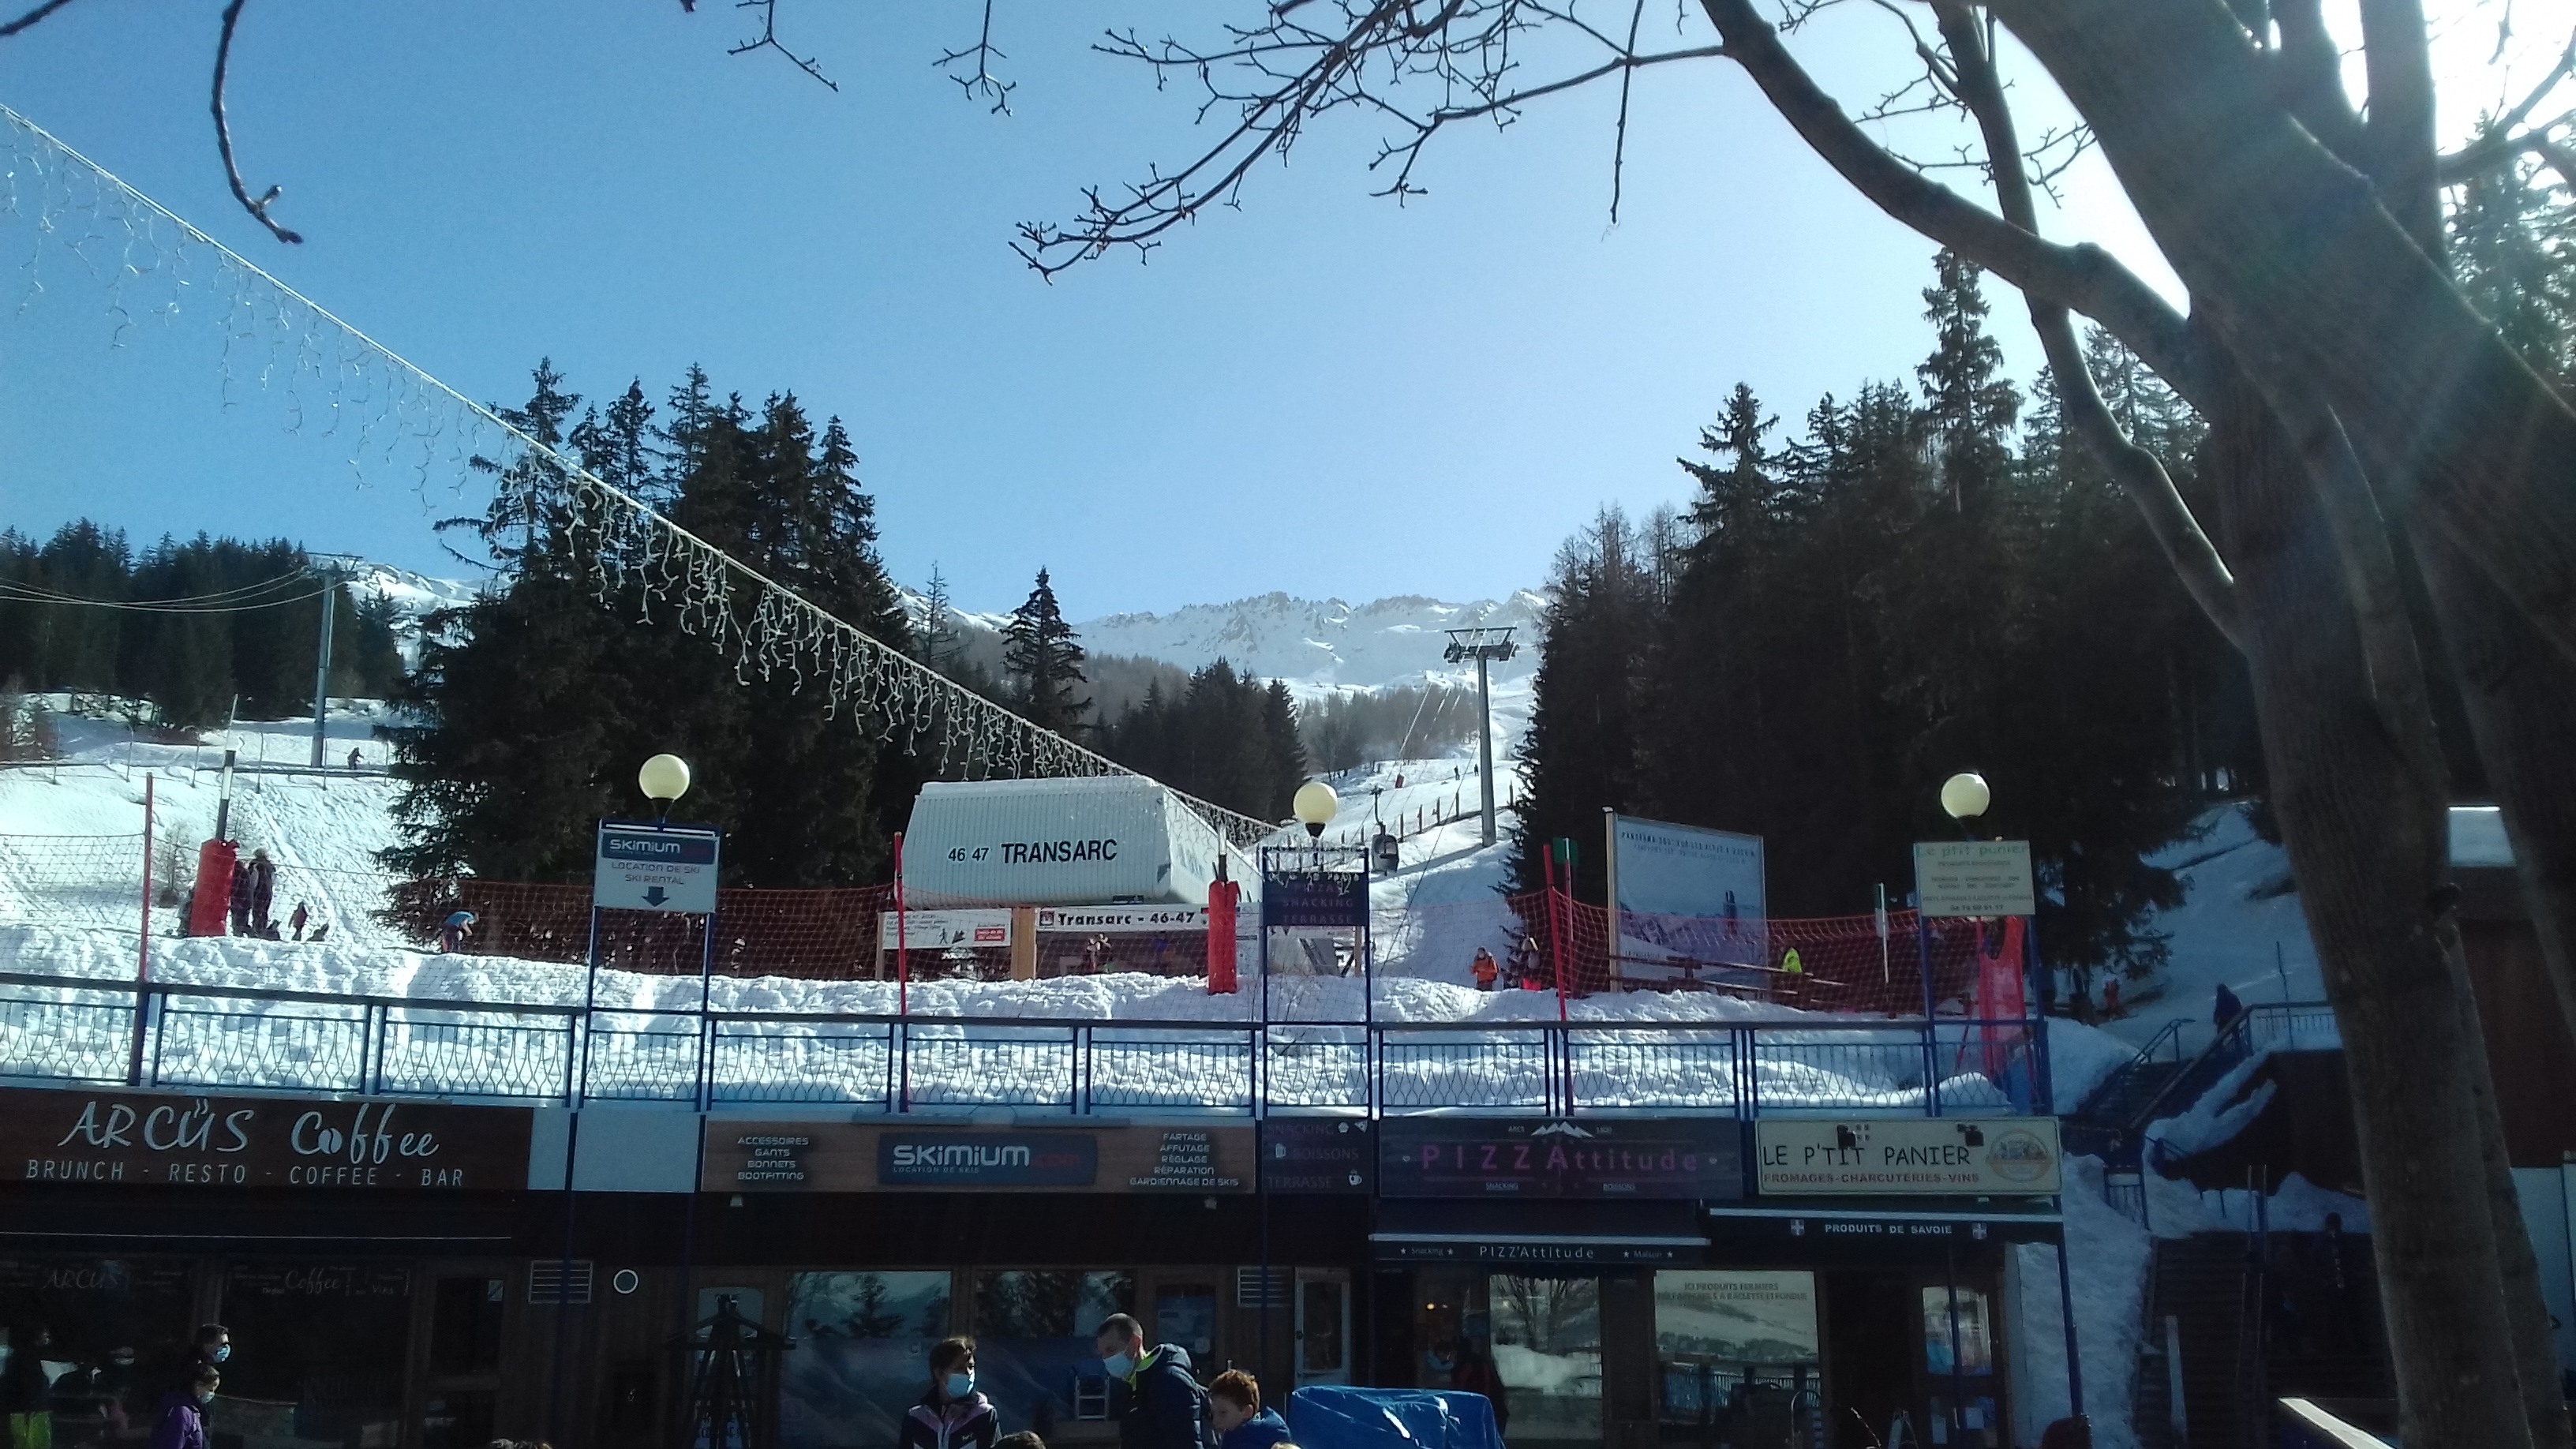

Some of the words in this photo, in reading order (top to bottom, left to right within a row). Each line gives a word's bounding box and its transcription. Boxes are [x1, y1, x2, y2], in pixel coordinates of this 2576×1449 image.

[948, 848, 965, 862] 46
[972, 847, 990, 861] 47
[1001, 838, 1118, 863] TRANSARC
[666, 865, 681, 874] DE
[683, 866, 701, 874] SKI
[624, 874, 642, 882] SKI
[1282, 898, 1354, 908] SNACKING
[1058, 912, 1132, 927] Transarc
[1149, 912, 1196, 924] 46-47
[291, 1103, 440, 1166] Coffee
[1163, 1133, 1208, 1142] FARTAGE
[737, 1136, 810, 1146] ACCESSOIRES
[754, 1148, 791, 1158] GANTS
[1159, 1144, 1211, 1153] AFFUTAGE
[1161, 1154, 1208, 1164] RÉGLAGE
[1763, 1145, 1788, 1166] LE
[1804, 1144, 1866, 1166] P'TIT
[1884, 1144, 1971, 1166] PANIER
[747, 1160, 796, 1169] BONNETS
[26, 1159, 125, 1181] BRUNCH
[169, 1163, 247, 1184] RESTO
[290, 1166, 377, 1186] COFFEE
[421, 1168, 464, 1187] BAR
[1154, 1165, 1215, 1175] RÉPARATION
[737, 1172, 805, 1181] BOOTFITTING
[1129, 1177, 1200, 1186] GARDIENNAGE
[1217, 1178, 1240, 1187] SKIS
[1824, 1223, 1883, 1235] PRODUITS
[1889, 1225, 1905, 1234] DE
[1910, 1225, 1953, 1235] SAVOIE
[1479, 1245, 1594, 1259] PIZZ'Attitude
